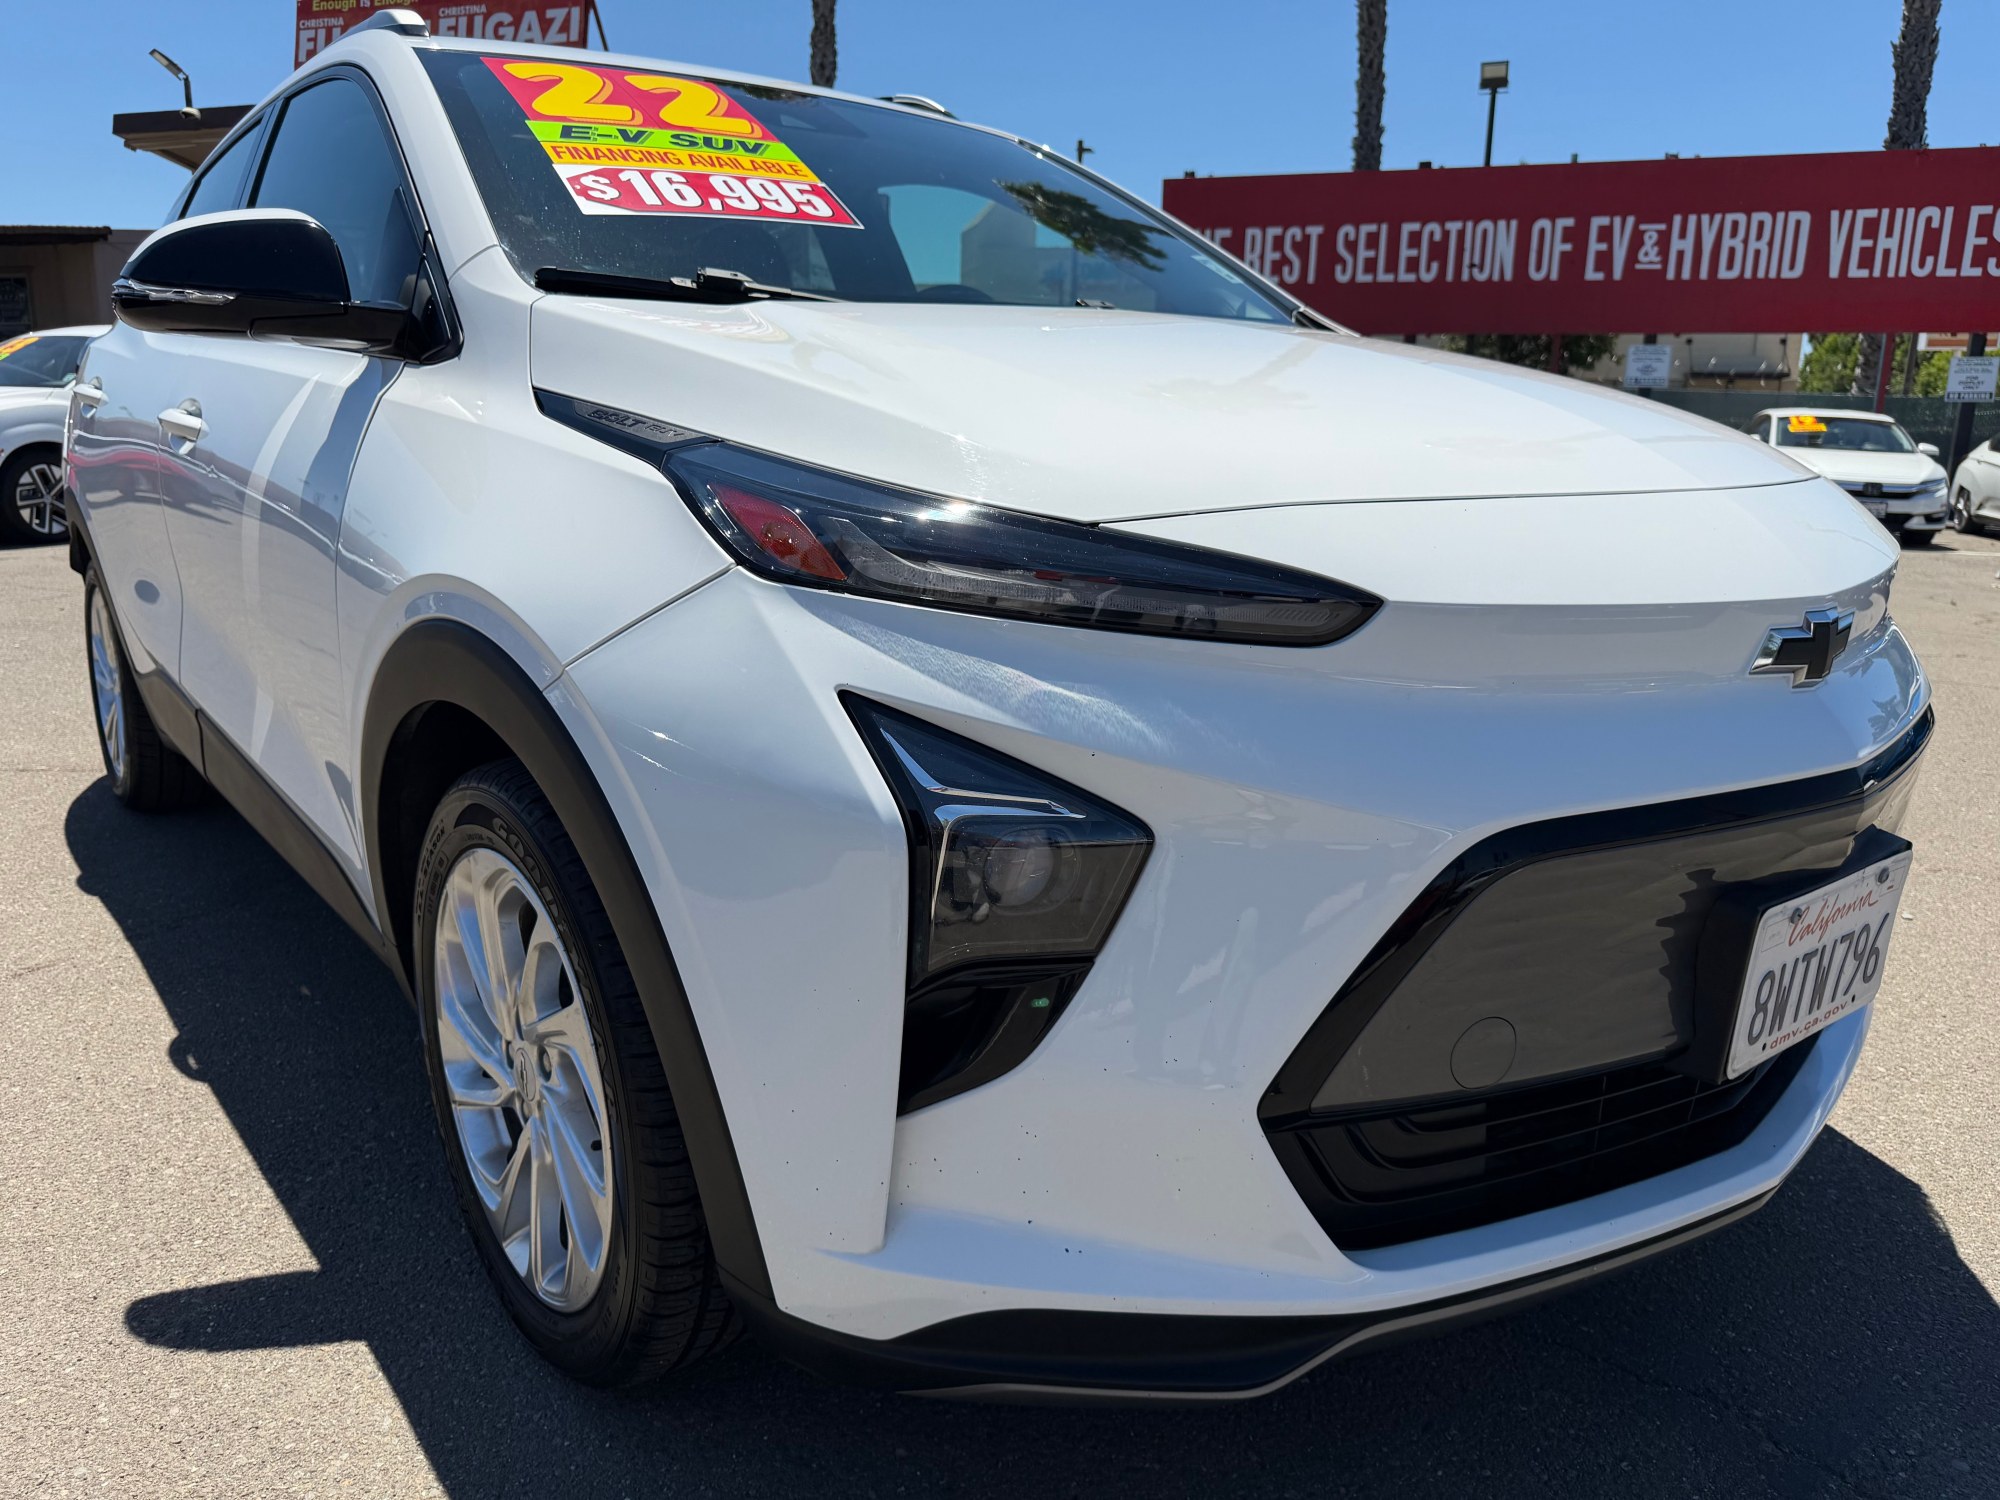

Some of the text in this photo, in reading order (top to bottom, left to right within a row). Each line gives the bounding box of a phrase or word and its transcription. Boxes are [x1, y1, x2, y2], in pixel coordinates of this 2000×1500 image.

[300, 17, 345, 28] CHRISTINA
[312, 0, 356, 11] Enough
[438, 4, 487, 17] CHRISTINA
[437, 6, 581, 44] FUGAZI
[503, 62, 762, 138] 22
[559, 124, 770, 156] E-V SUV
[553, 145, 809, 178] FINANCING AVAILABLE
[586, 169, 834, 218] $16,995
[1243, 225, 1324, 285] BEST
[1334, 218, 1518, 284] SELECTION
[1528, 217, 1576, 282] OF
[1584, 215, 1635, 281] EV
[1666, 210, 1812, 281] HYBRID
[586, 408, 646, 429] BOLT
[1788, 889, 1879, 947] California
[1748, 912, 1890, 1046] 8WTW796
[1769, 1001, 1849, 1051] dmv.ca.gov
